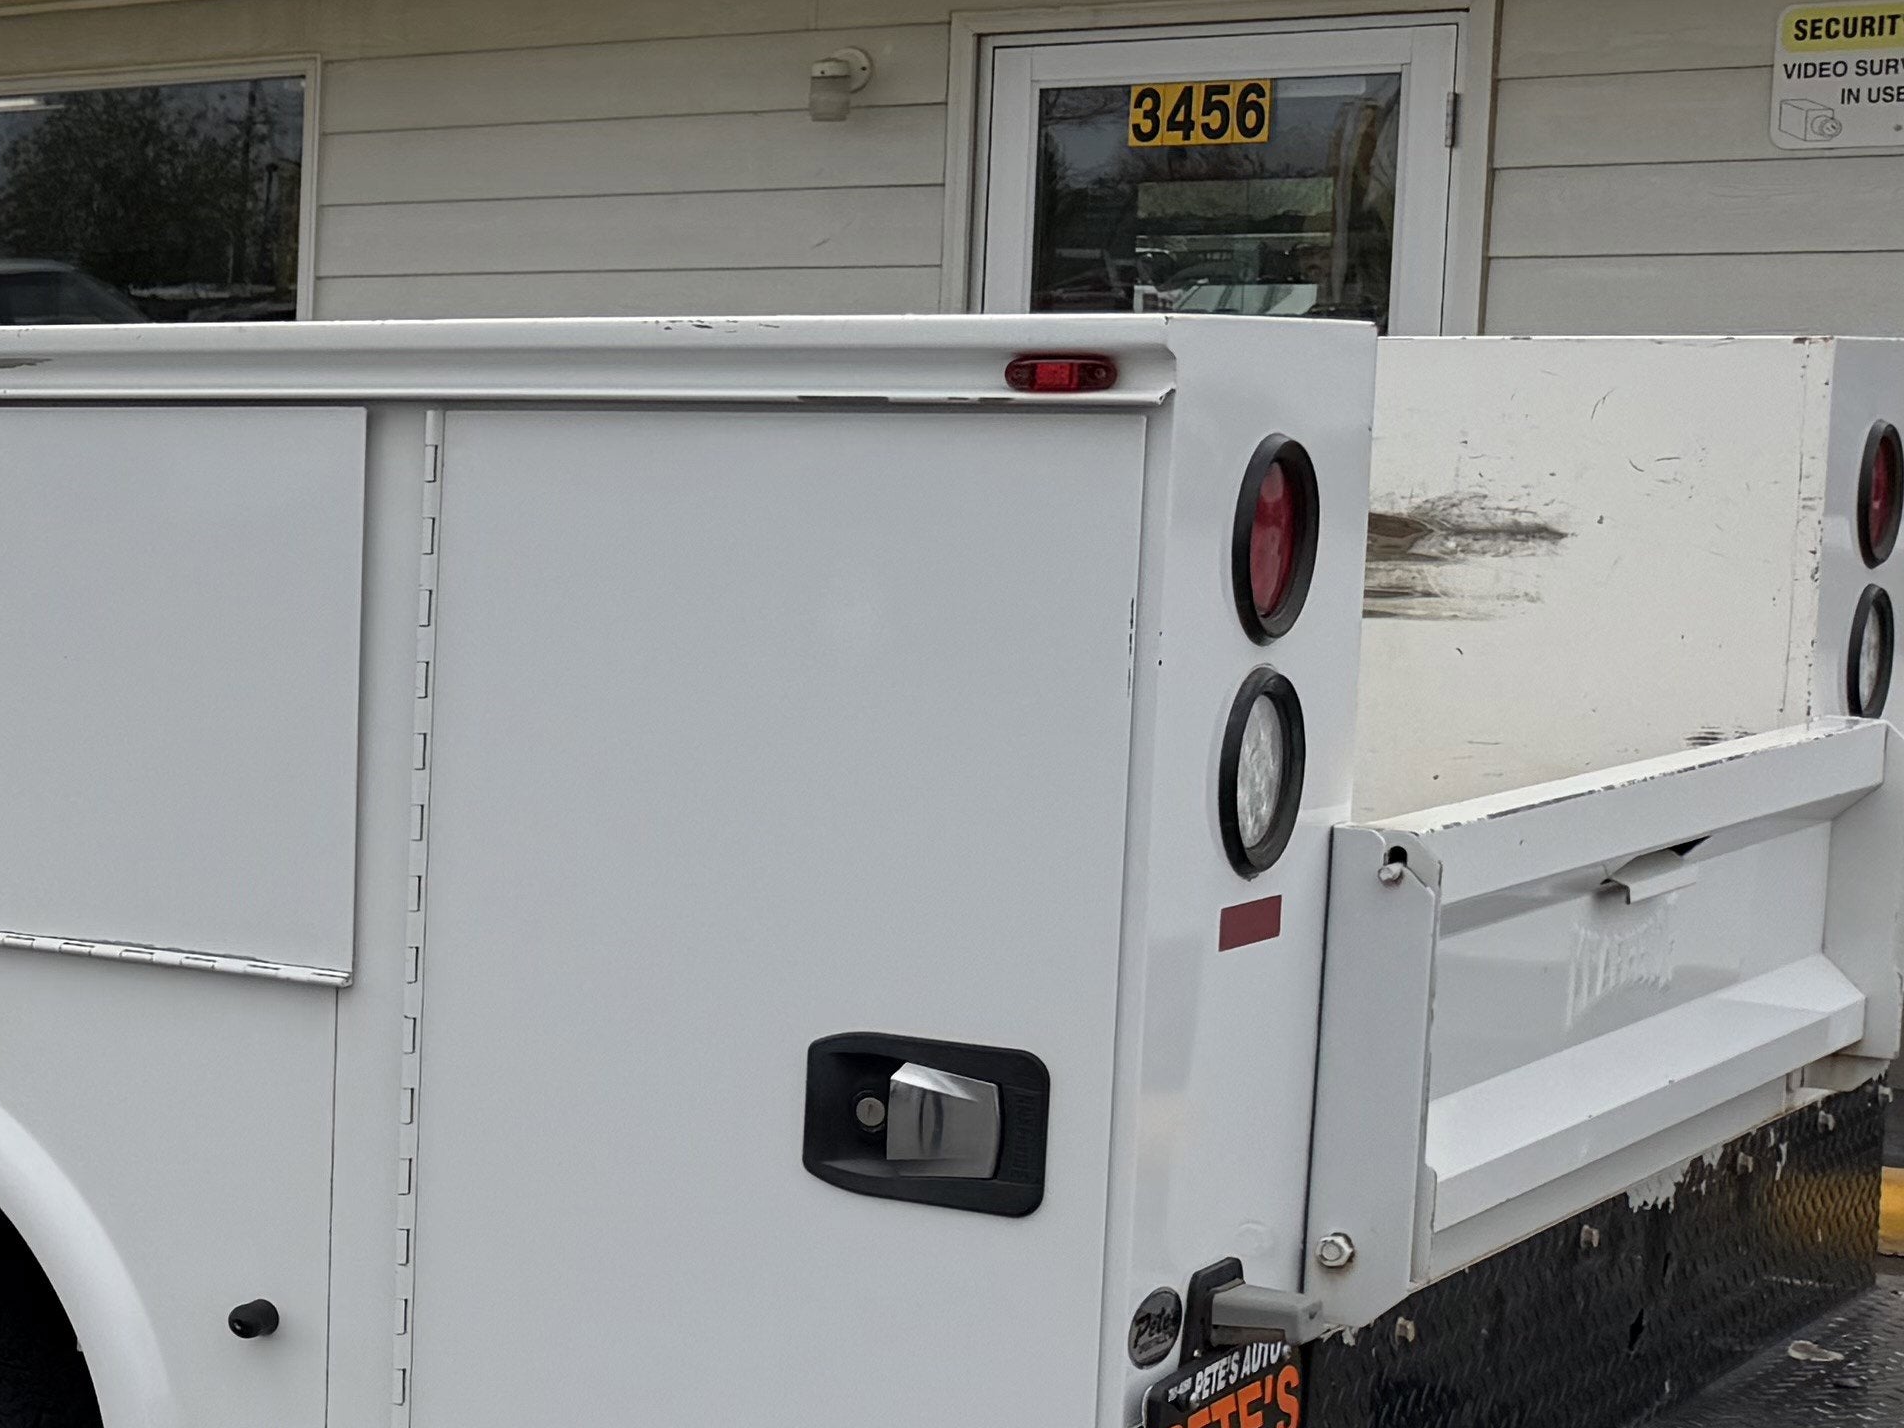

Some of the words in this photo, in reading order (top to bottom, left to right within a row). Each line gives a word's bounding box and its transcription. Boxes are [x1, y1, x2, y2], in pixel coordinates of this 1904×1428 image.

[1794, 14, 1904, 41] SECURIT
[1784, 60, 1848, 79] VIDEO
[1841, 88, 1860, 104] IN
[1867, 86, 1904, 103] USE
[1132, 83, 1266, 143] 3456
[1194, 1351, 1240, 1400] PETE'S
[1241, 1341, 1282, 1379] AUTO
